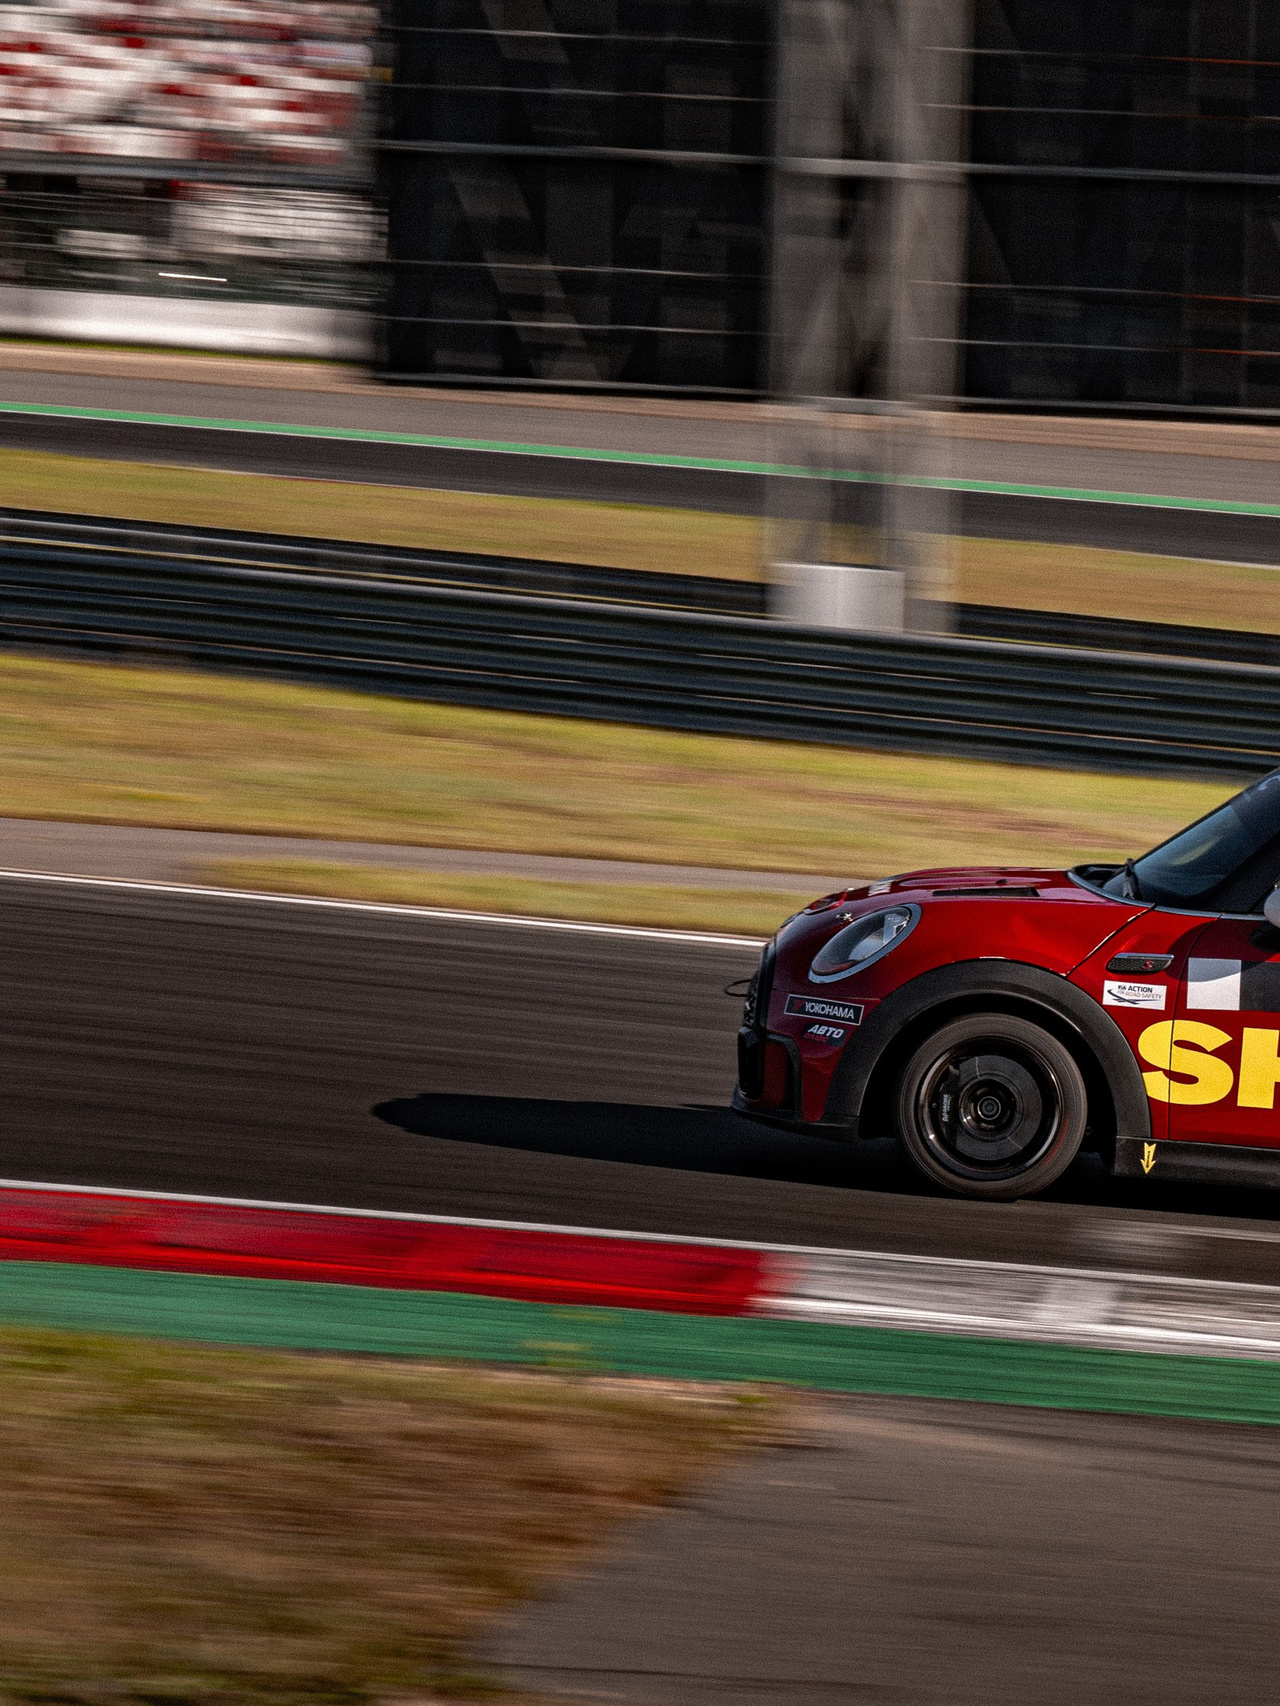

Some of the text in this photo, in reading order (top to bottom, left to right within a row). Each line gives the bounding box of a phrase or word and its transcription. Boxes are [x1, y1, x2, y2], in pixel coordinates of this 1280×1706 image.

[1128, 985, 1153, 993] ACTION
[804, 1001, 855, 1020] YOKOHAMA
[807, 1024, 845, 1038] АВТО
